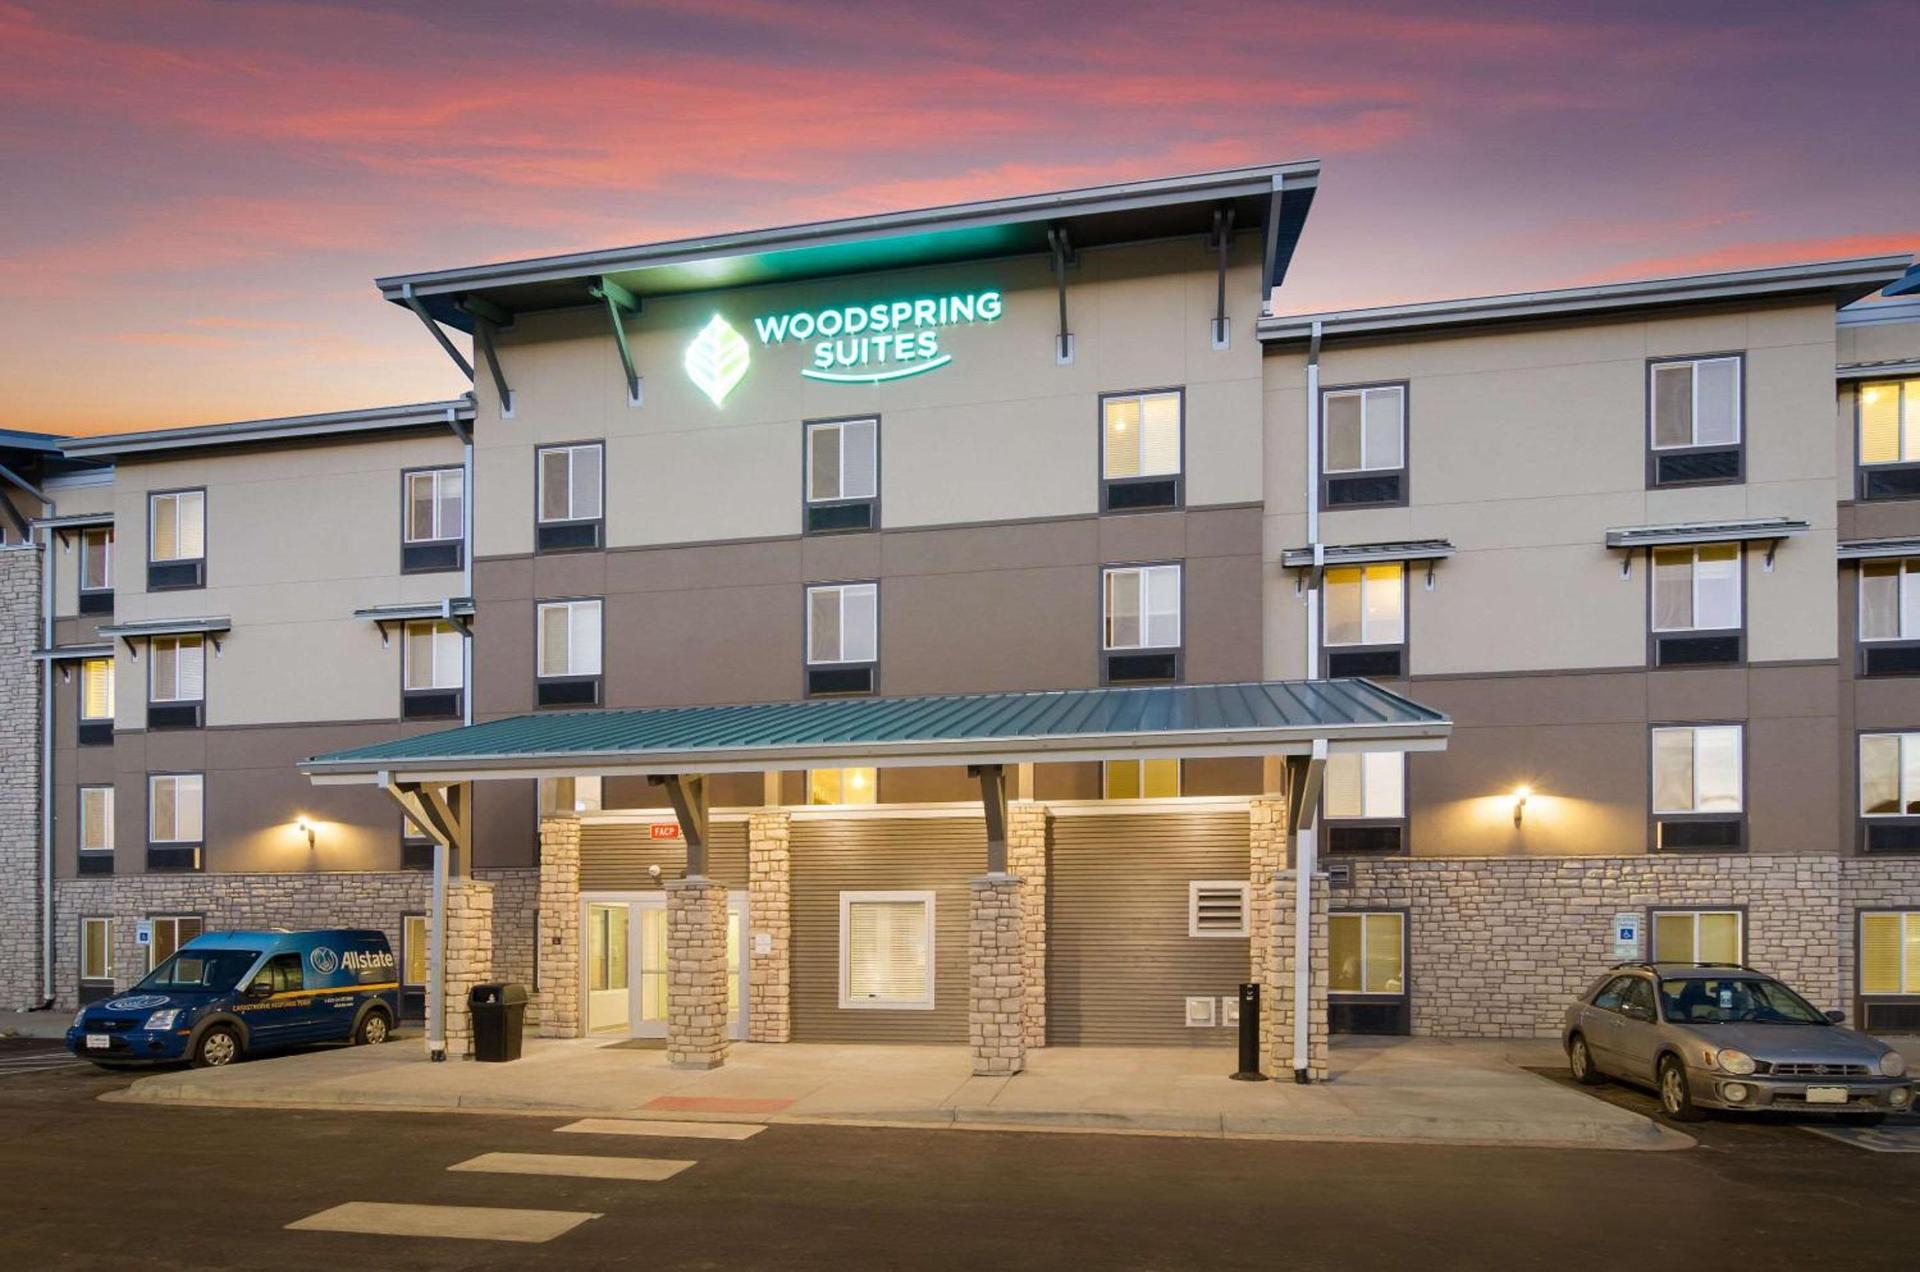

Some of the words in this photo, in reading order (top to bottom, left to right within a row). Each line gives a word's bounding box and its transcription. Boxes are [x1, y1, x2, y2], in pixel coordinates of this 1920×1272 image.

[755, 292, 1001, 344] WOODSPRING
[815, 331, 939, 368] SUITES
[341, 950, 394, 970] Allstate
